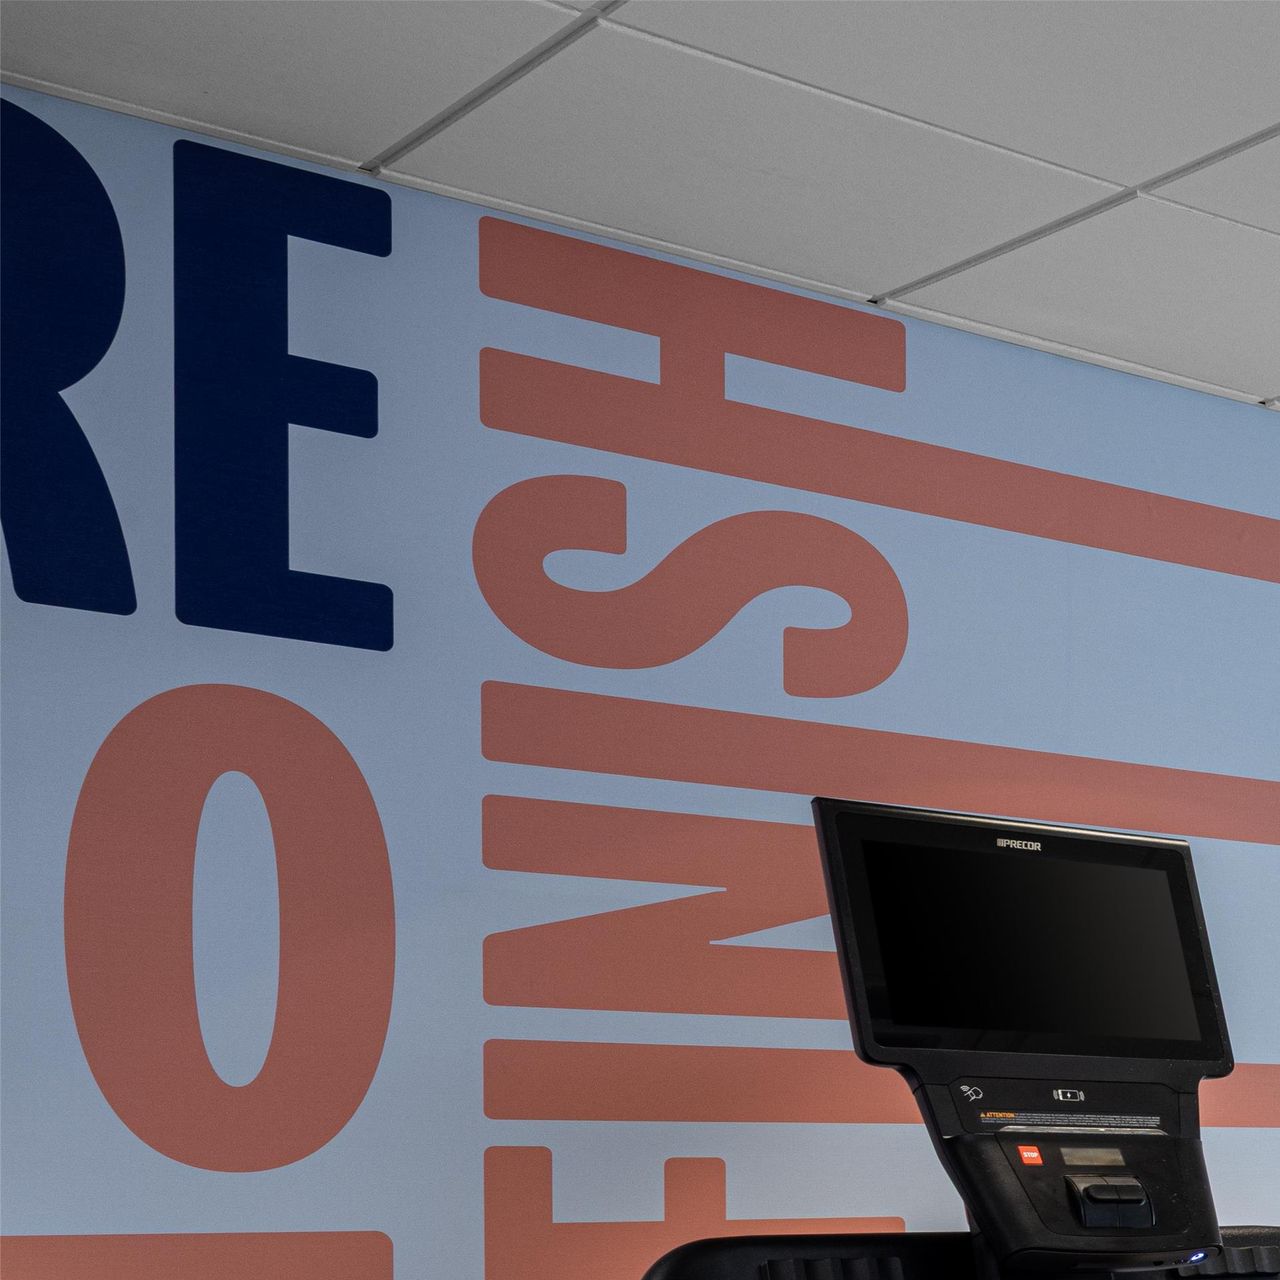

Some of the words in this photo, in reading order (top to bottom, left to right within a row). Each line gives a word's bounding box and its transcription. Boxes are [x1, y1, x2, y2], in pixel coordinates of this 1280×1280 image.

[1003, 838, 1042, 852] PRECOR
[985, 1111, 1015, 1119] ATTENTION
[1023, 1151, 1039, 1159] STOP
